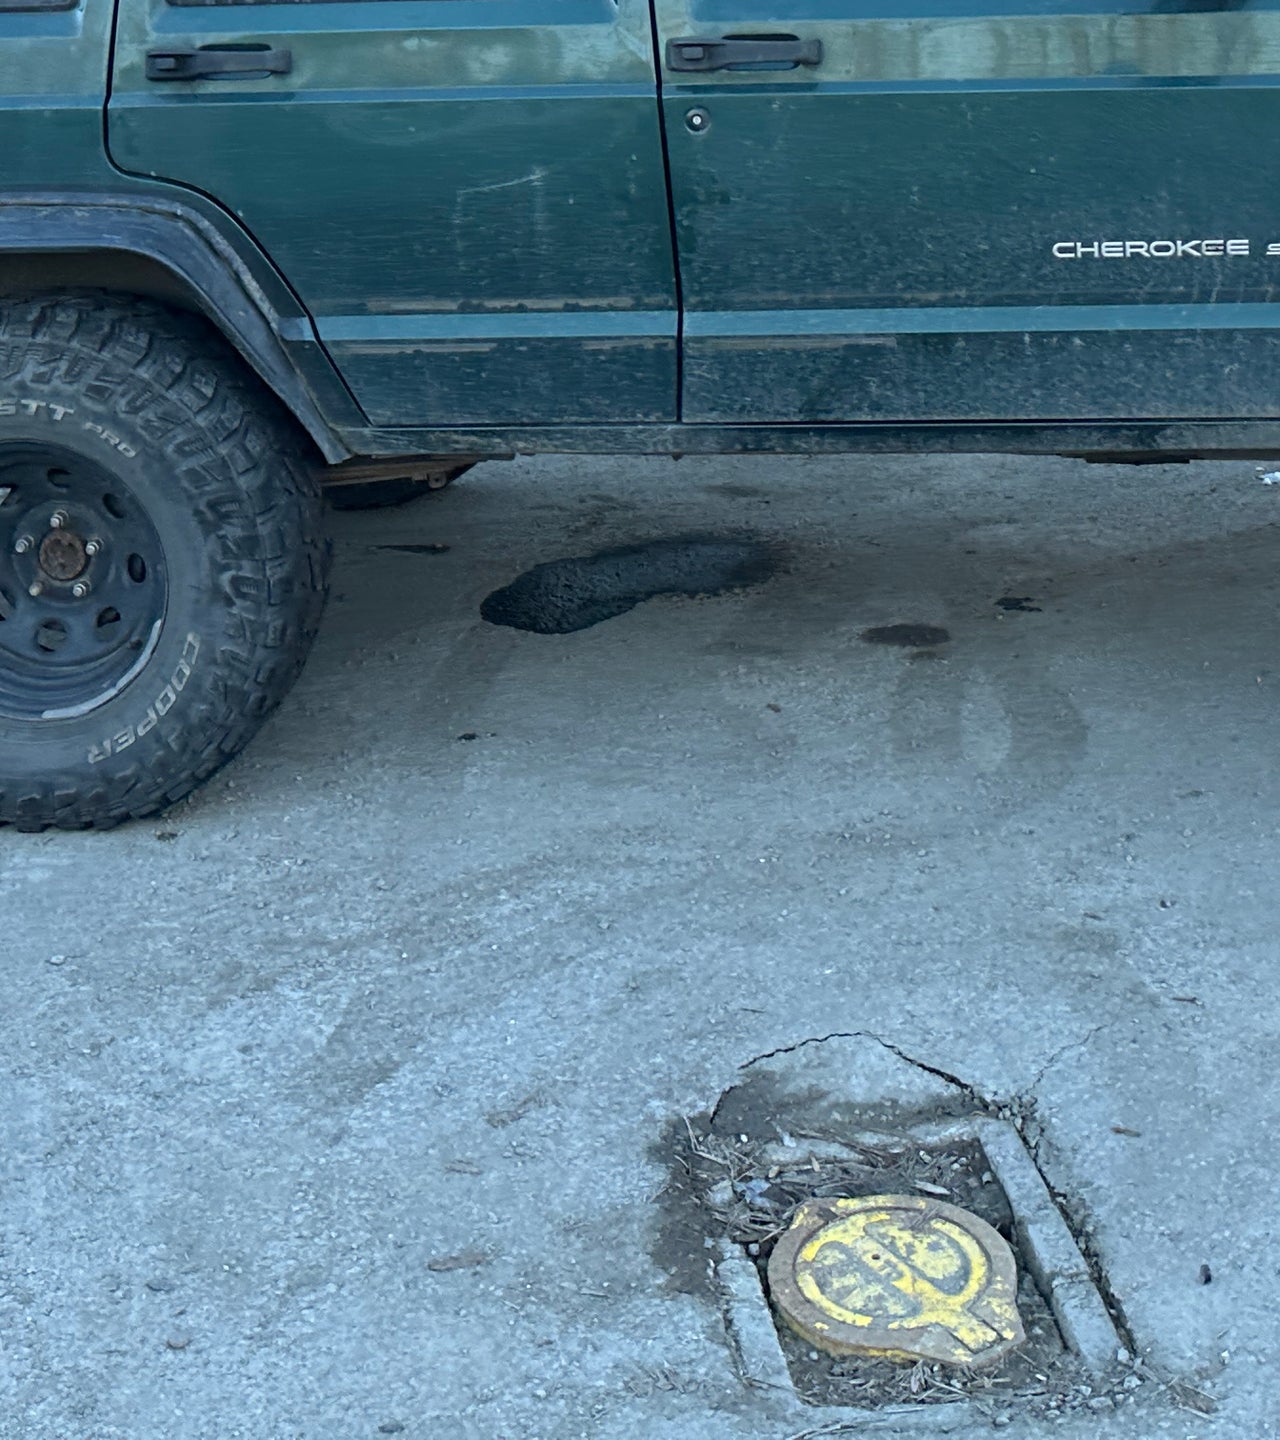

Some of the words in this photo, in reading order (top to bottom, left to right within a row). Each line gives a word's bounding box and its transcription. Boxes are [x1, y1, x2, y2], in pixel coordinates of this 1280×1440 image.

[1052, 239, 1250, 258] CHEROKEE
[83, 421, 136, 458] PRO
[87, 632, 201, 764] COOPER
